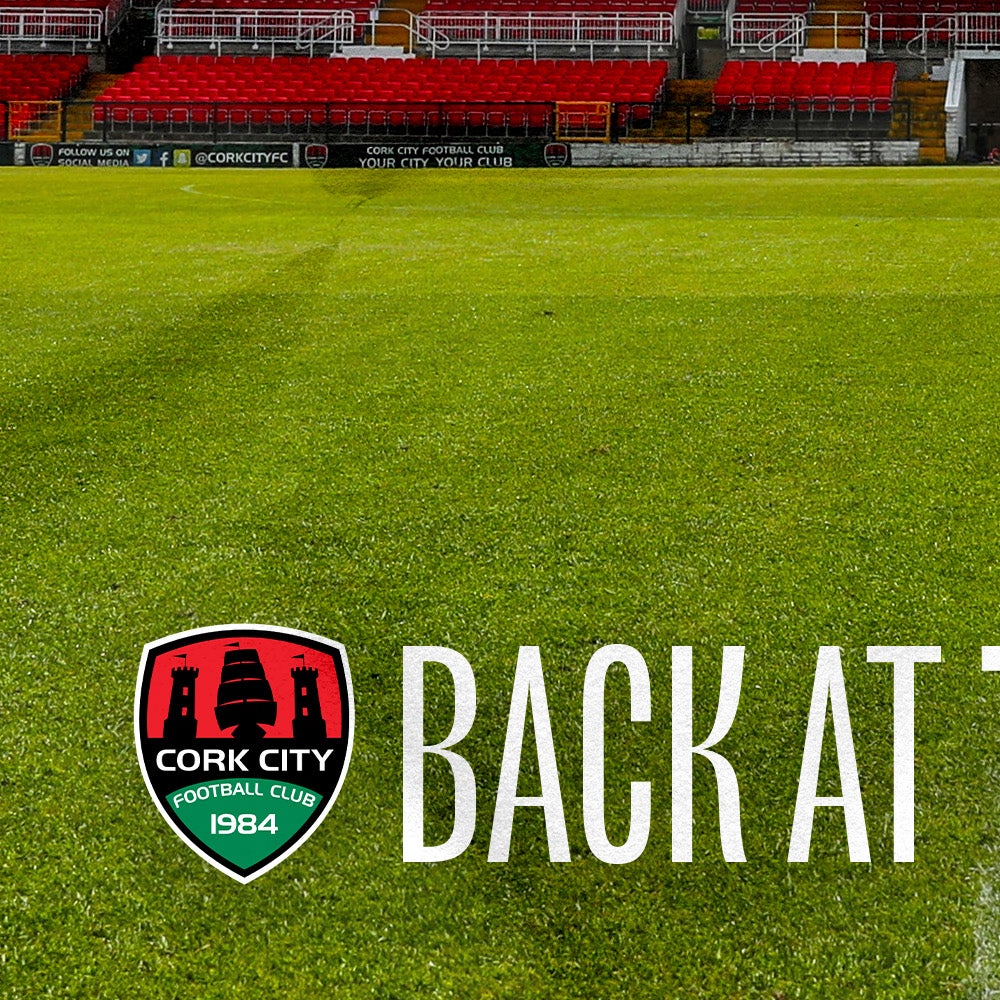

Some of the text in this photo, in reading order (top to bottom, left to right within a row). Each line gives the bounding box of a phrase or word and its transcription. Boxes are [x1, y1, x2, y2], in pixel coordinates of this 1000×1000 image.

[58, 147, 130, 157] FOLLOW US ON
[366, 145, 504, 155] CORK CITY FOOTBALL CLUB
[58, 158, 93, 167] SOCIAL
[97, 158, 130, 167] MEDIA
[195, 152, 289, 165] @CORKCITYFC
[359, 156, 513, 168] YOUR CITY YOUR CLUB
